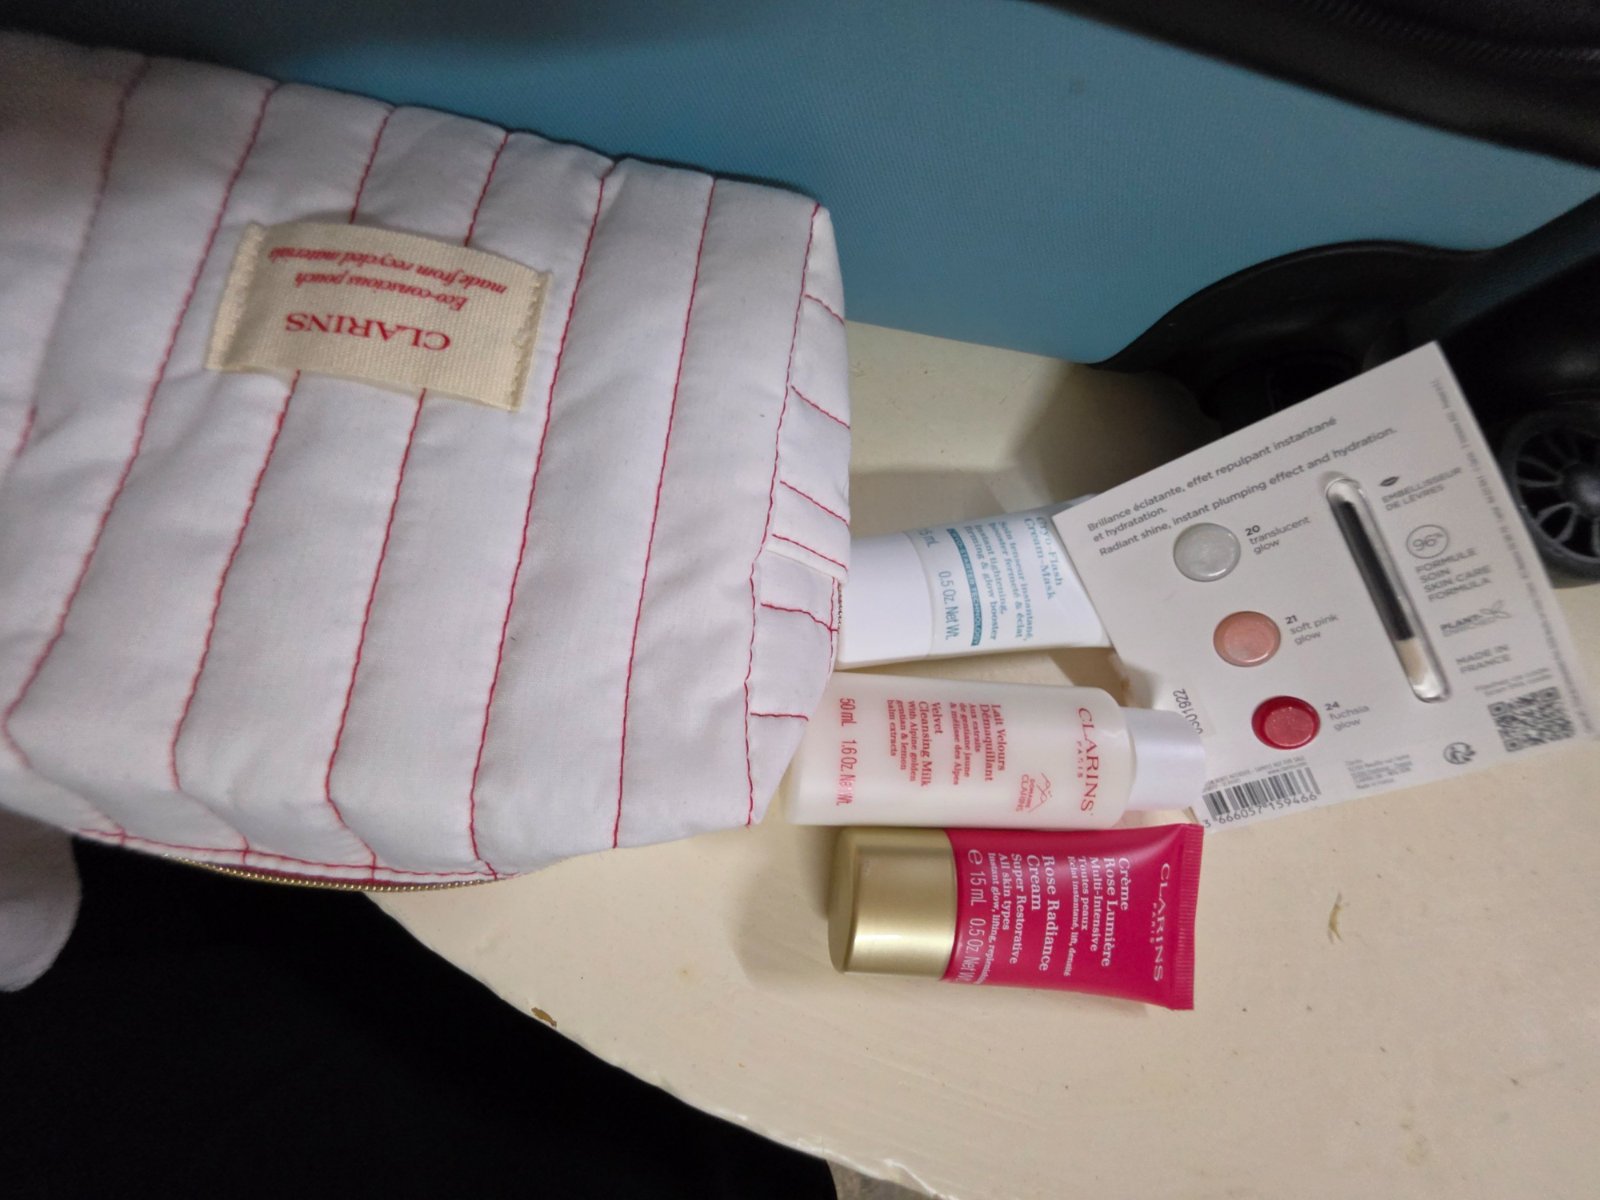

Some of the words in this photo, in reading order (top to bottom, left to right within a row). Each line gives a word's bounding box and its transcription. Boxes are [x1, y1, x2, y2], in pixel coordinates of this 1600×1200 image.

[267, 246, 342, 264] materials
[339, 251, 414, 273] recycled
[294, 270, 349, 288] pouch
[416, 263, 463, 286] from
[458, 274, 508, 294] made
[349, 273, 469, 312] Eco-conscious
[285, 312, 451, 351] CLARINS
[1086, 507, 1131, 532] Brillance
[1132, 485, 1186, 512] éclatante,
[1186, 471, 1214, 489] effet
[1215, 446, 1271, 478] repulpant
[1273, 416, 1338, 456] instantané
[1099, 533, 1139, 557] Radiant
[1140, 521, 1173, 543] shine,
[1172, 505, 1210, 527] instant
[1212, 481, 1267, 513] plumping
[1268, 464, 1304, 486] effect
[1306, 452, 1331, 469] and
[1332, 426, 1398, 461] hydration.
[1385, 500, 1401, 512] DE
[1092, 532, 1105, 543] et
[1104, 507, 1168, 541] hydratation.
[1244, 525, 1261, 536] 20
[1249, 516, 1311, 545] translucent
[1253, 539, 1280, 555] glow
[981, 561, 989, 570] &
[1415, 547, 1477, 574] FORMULE
[938, 571, 955, 587] 0.5
[982, 572, 996, 599] glow
[989, 556, 1008, 615] tightening,
[1005, 558, 1021, 599] fermeté
[1419, 567, 1452, 583] SOIN
[1424, 578, 1455, 593] SKIN
[1455, 564, 1492, 583] CARE
[942, 589, 957, 605] Oz.
[1009, 541, 1025, 581] tenseur
[1020, 583, 1034, 641] instantané,
[1427, 577, 1493, 602] FORMULA
[945, 606, 960, 623] Net
[1014, 600, 1023, 610] &
[945, 623, 960, 641] Wt.
[990, 600, 999, 641] booster
[1015, 611, 1025, 639] éclat
[1285, 615, 1298, 625] 21
[1289, 622, 1312, 635] soft
[1313, 613, 1339, 629] pink
[1294, 631, 1322, 646] glow
[1455, 649, 1492, 665] MADE
[1494, 644, 1510, 653] IN
[1459, 653, 1512, 674] FRANCE
[839, 697, 856, 711] 50
[886, 699, 896, 721] balm
[908, 700, 916, 720] With
[959, 702, 968, 711] de
[969, 703, 977, 720] Aux
[991, 703, 1004, 726] Lait
[1324, 701, 1340, 711] 24
[1328, 703, 1370, 722] fuchsia
[840, 711, 858, 727] mL
[918, 700, 933, 758] Cleansing
[931, 701, 944, 735] Velvet
[960, 712, 970, 750] gentiane
[1333, 717, 1361, 732] glow
[841, 739, 858, 755] 1.6
[888, 721, 898, 757] extracts
[908, 721, 919, 750] Alpine
[971, 721, 981, 753] extraits
[979, 703, 996, 782] Démaquillant
[900, 741, 909, 771] lemon
[954, 744, 963, 759] des
[996, 728, 1008, 771] Velours
[1077, 707, 1099, 812] CLARINS
[840, 755, 858, 772] Oz.
[908, 751, 919, 782] golden
[920, 760, 933, 787] Milk
[951, 761, 963, 786] Alpes
[963, 752, 973, 778] jaune
[1015, 774, 1029, 813] CLARINS
[1204, 819, 1212, 829] 3
[1218, 806, 1263, 826] 666057
[1268, 793, 1319, 812] 159466
[988, 852, 999, 885] Instant
[998, 853, 1011, 869] All
[1011, 853, 1025, 892] Super
[969, 871, 986, 886] 15
[1002, 872, 1012, 897] skin
[1026, 854, 1042, 911] Cream
[1042, 855, 1057, 895] Rose
[1078, 856, 1090, 894] Toutes
[1103, 857, 1116, 896] Rose
[1118, 857, 1132, 911] Crème
[970, 888, 987, 906] mL
[991, 886, 1001, 912] glow,
[1070, 880, 1080, 930] instantané,
[1089, 856, 1104, 952] Multi-Intensive
[968, 918, 986, 936] 0.5
[1001, 900, 1012, 931] types
[1080, 897, 1089, 931] peaux
[1154, 863, 1170, 981] CLARINS
[988, 914, 1001, 944] lifting,
[1009, 895, 1027, 964] Restorative
[1038, 899, 1060, 972] Radiance
[1069, 931, 1079, 946] lift,
[1101, 900, 1118, 967] Lumière
[965, 938, 984, 954] Oz.
[961, 956, 980, 971] Net
[1063, 947, 1077, 977] densité
